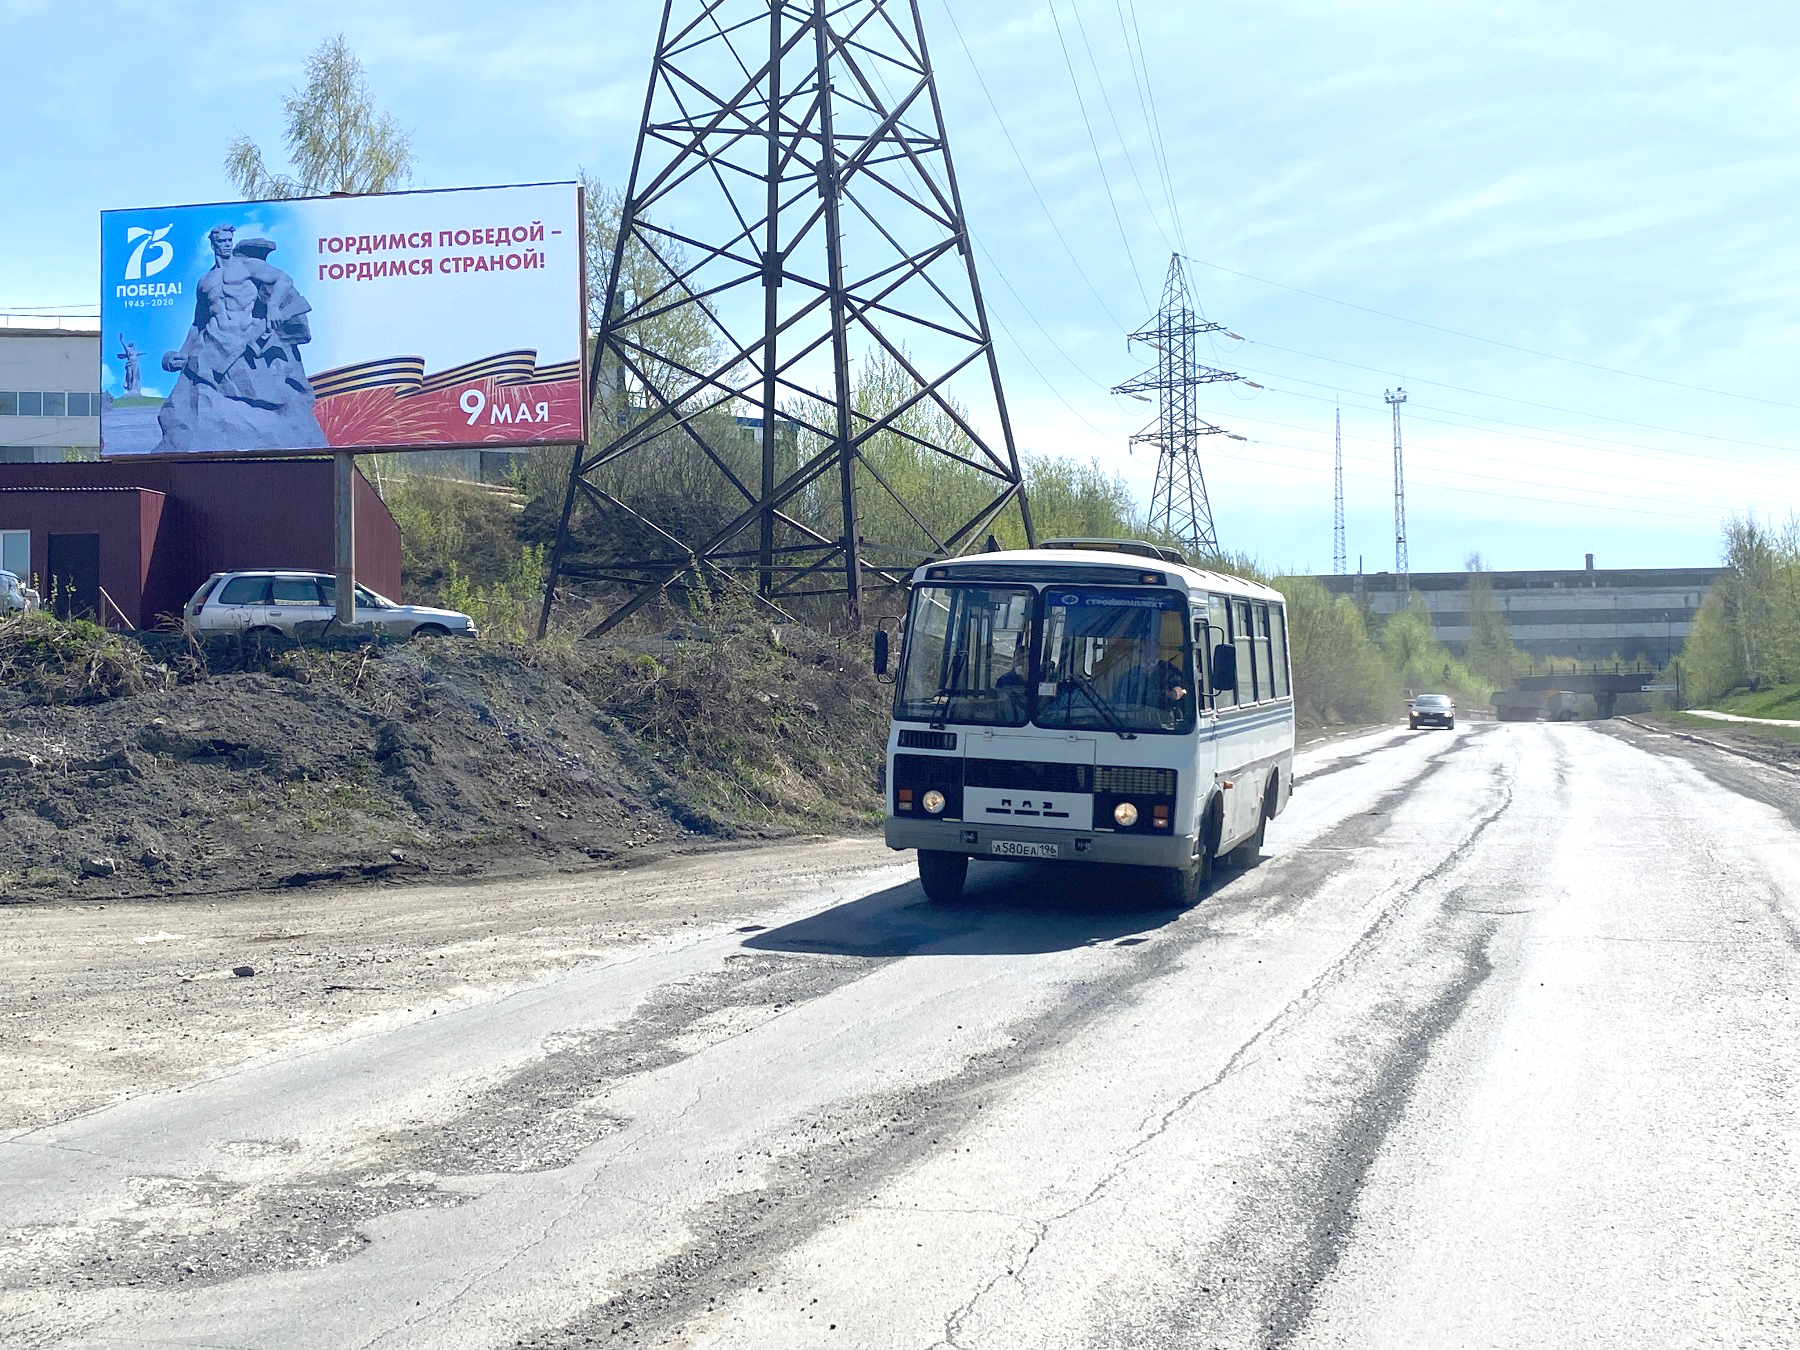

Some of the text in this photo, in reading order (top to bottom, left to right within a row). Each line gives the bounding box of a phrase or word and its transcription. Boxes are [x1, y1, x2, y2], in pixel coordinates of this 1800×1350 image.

[125, 223, 174, 280] 75
[318, 232, 432, 254] ГОРДИМСЯ
[439, 220, 544, 247] ПОБЕДОЙ
[318, 248, 545, 281] ГОРДИМСЯ СТРАНОЙ!
[116, 282, 182, 298] ПОБЕДА!
[459, 389, 549, 426] 9 МАЯ
